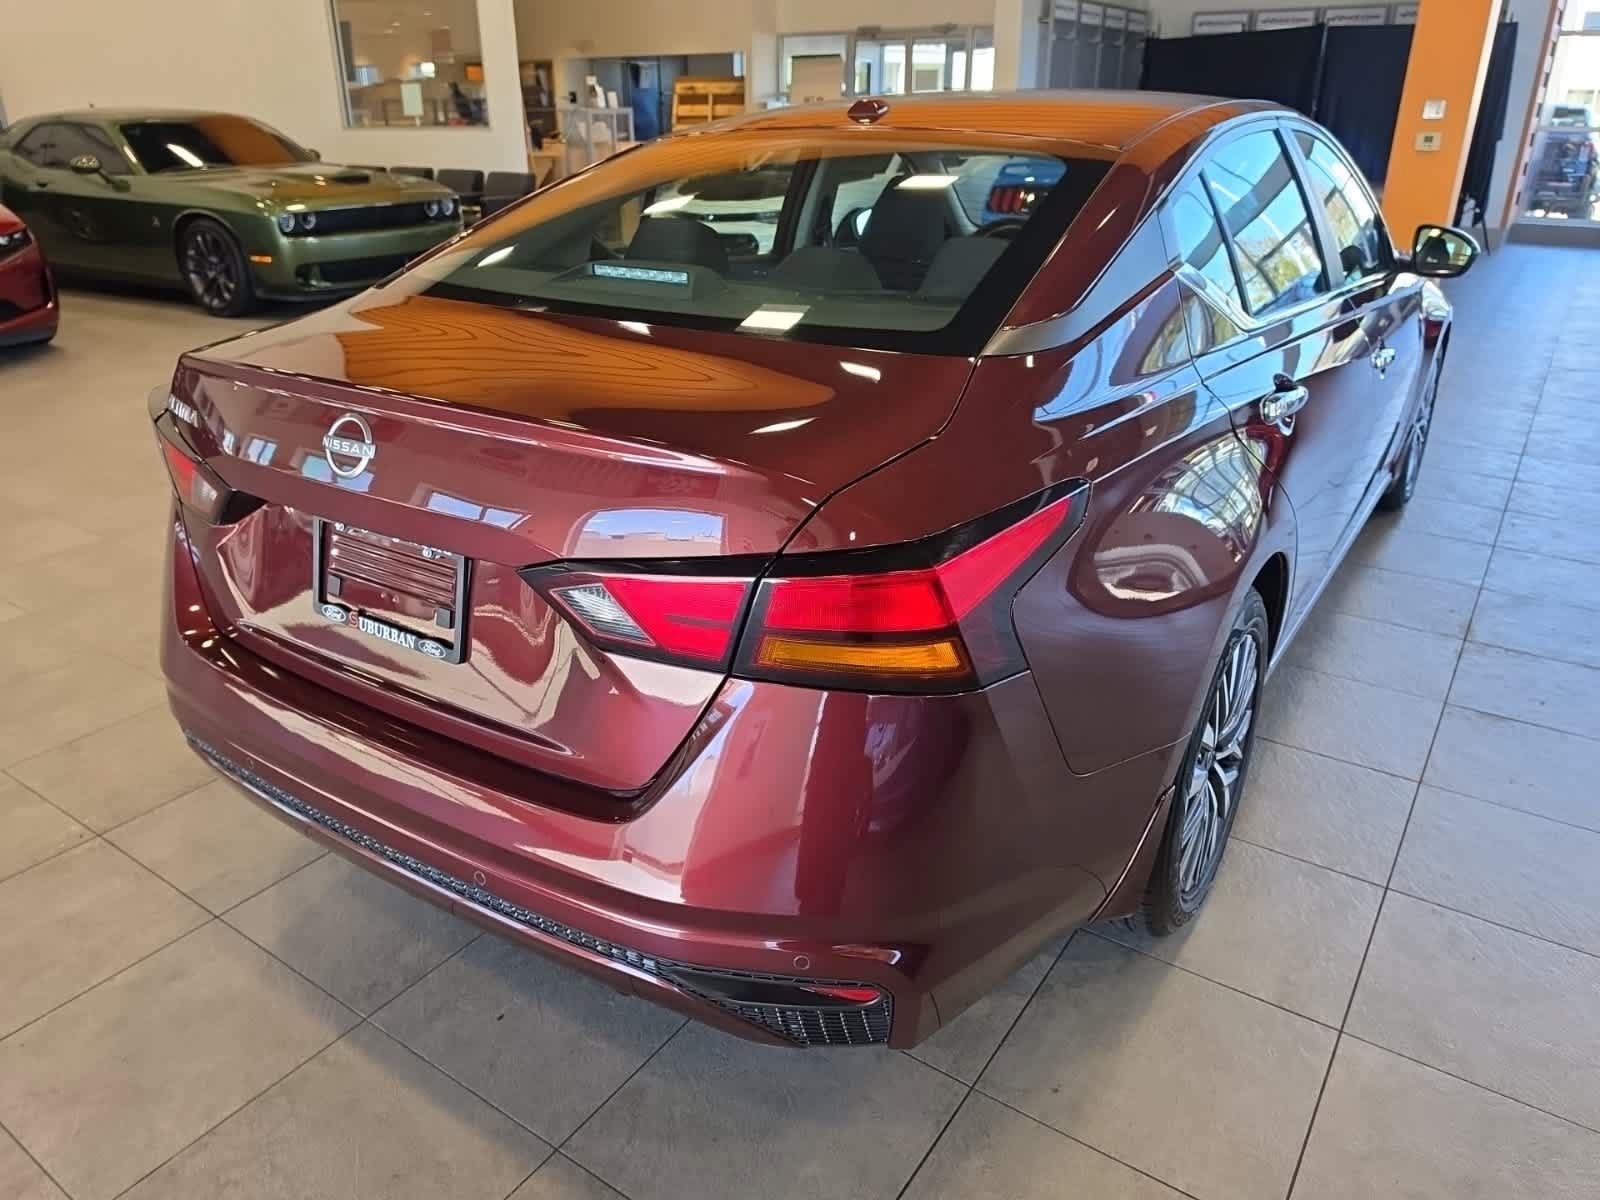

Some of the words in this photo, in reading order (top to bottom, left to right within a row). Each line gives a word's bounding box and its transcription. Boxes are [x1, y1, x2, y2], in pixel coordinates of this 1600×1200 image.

[322, 434, 376, 459] NISSAN
[323, 605, 344, 621] Ford
[348, 611, 416, 649] SUBURBAN
[421, 640, 443, 656] Ford
